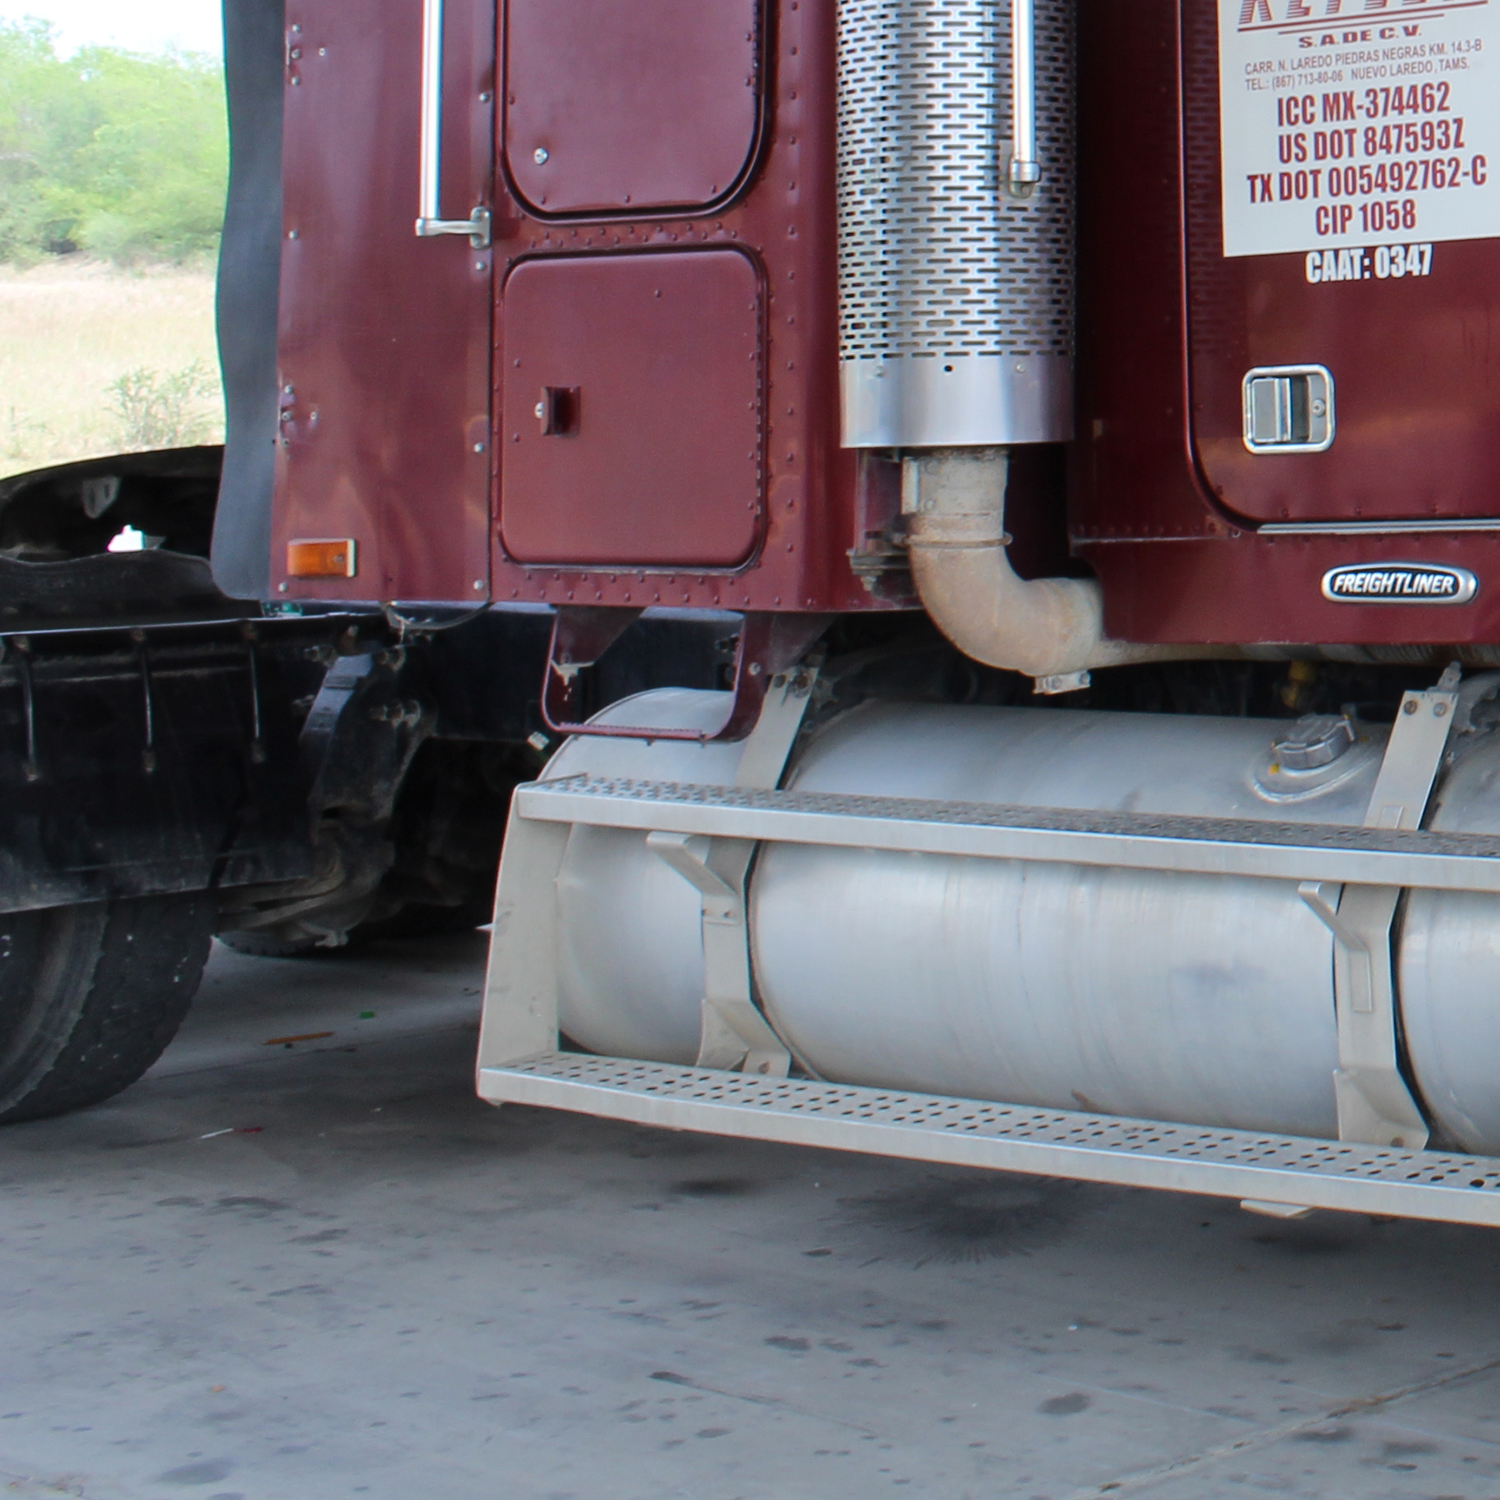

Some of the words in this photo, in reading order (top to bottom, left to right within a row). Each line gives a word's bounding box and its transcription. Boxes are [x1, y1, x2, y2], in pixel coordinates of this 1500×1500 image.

[1245, 60, 1276, 75] CARR.
[1291, 54, 1333, 71] LAREDO
[1336, 49, 1380, 66] PIEDRAS
[1382, 44, 1426, 61] NEGRAS
[1429, 42, 1448, 56] KM.
[1272, 74, 1296, 92] (867)
[1351, 65, 1388, 80] NUEVO
[1439, 56, 1470, 72] TAMS.
[1277, 94, 1316, 127] ICC
[1322, 81, 1451, 123] MX-374462
[1278, 132, 1308, 164] US
[1313, 128, 1358, 161] DOT
[1246, 172, 1274, 204] TX
[1278, 168, 1322, 201] DOT
[1328, 154, 1488, 198] 005492762-C
[1315, 204, 1353, 236] CIP
[1358, 198, 1417, 233] 1058
[1304, 247, 1371, 285] CAAT:
[1374, 243, 1434, 280] 0347
[1333, 571, 1455, 594] FREIGHTLINER
